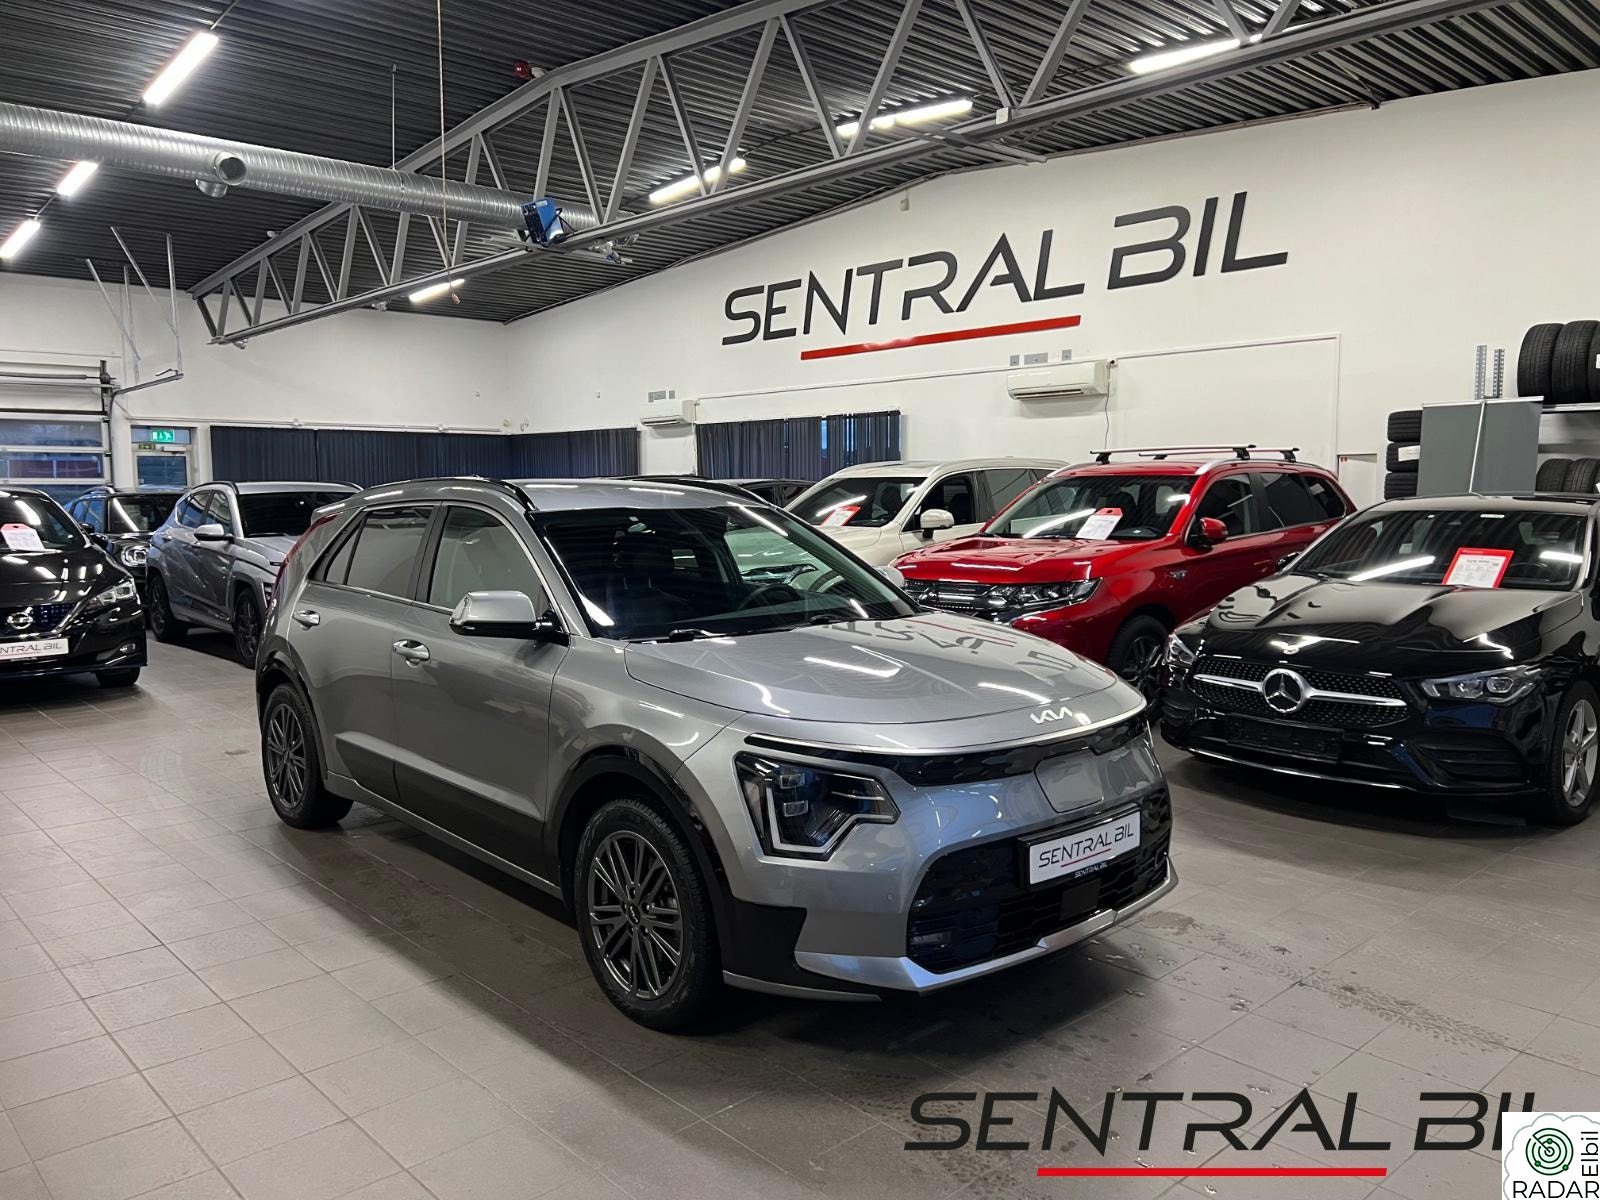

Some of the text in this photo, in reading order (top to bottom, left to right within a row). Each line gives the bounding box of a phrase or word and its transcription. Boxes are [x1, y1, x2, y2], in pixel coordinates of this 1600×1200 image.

[722, 191, 1289, 347] SENTRAL BIL
[1038, 823, 1134, 868] SENTRAL BIL
